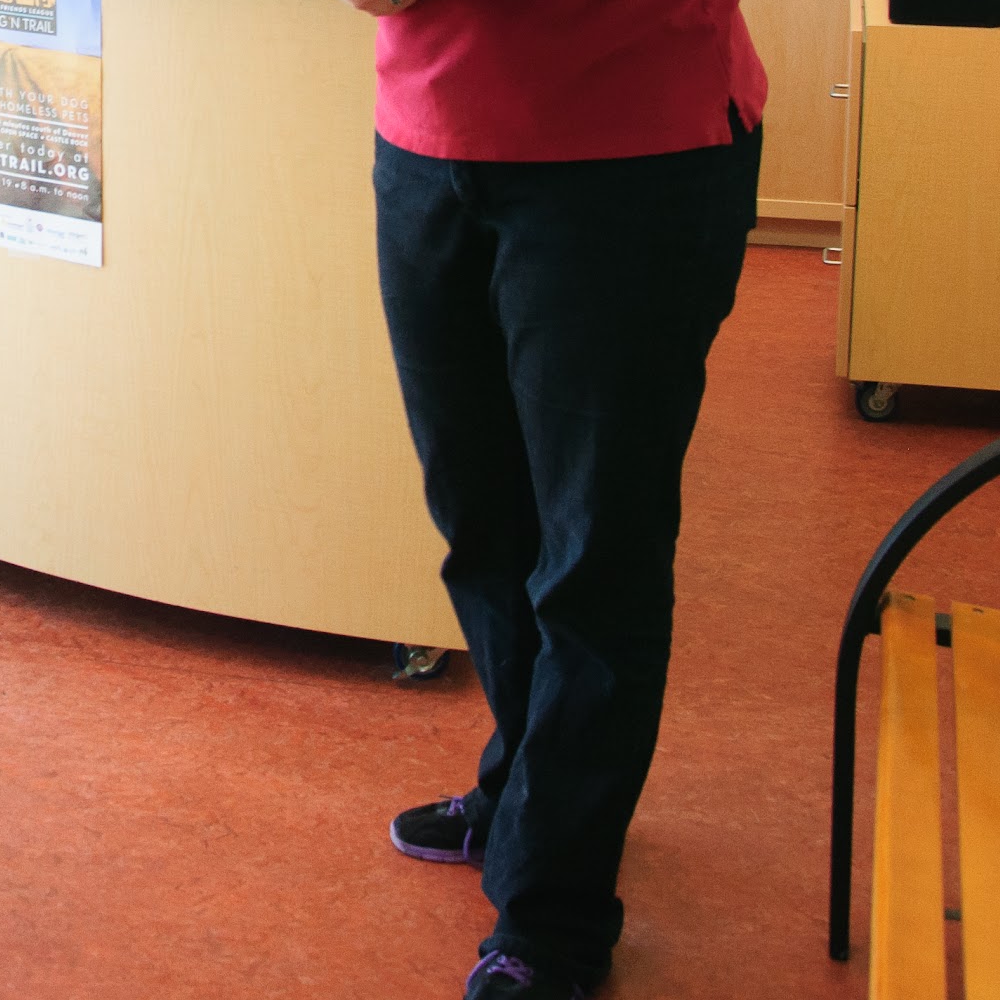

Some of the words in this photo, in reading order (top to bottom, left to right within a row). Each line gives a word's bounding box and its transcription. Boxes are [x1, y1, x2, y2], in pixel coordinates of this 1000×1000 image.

[0, 4, 27, 13] FRIENDS
[28, 8, 54, 16] LEAGUE
[22, 18, 54, 34] TRAIL
[19, 90, 54, 104] YOUR
[61, 96, 89, 110] DOG
[0, 100, 57, 118] HOMELESS
[62, 110, 89, 123] PETS
[31, 125, 51, 134] south
[62, 129, 89, 140] Denver
[46, 135, 69, 144] CASTLE
[20, 142, 65, 163] today
[73, 152, 89, 164] at
[2, 177, 13, 188] 19
[20, 180, 27, 190] 8
[30, 184, 50, 195] a.m.
[53, 187, 64, 197] to
[67, 191, 89, 201] noon
